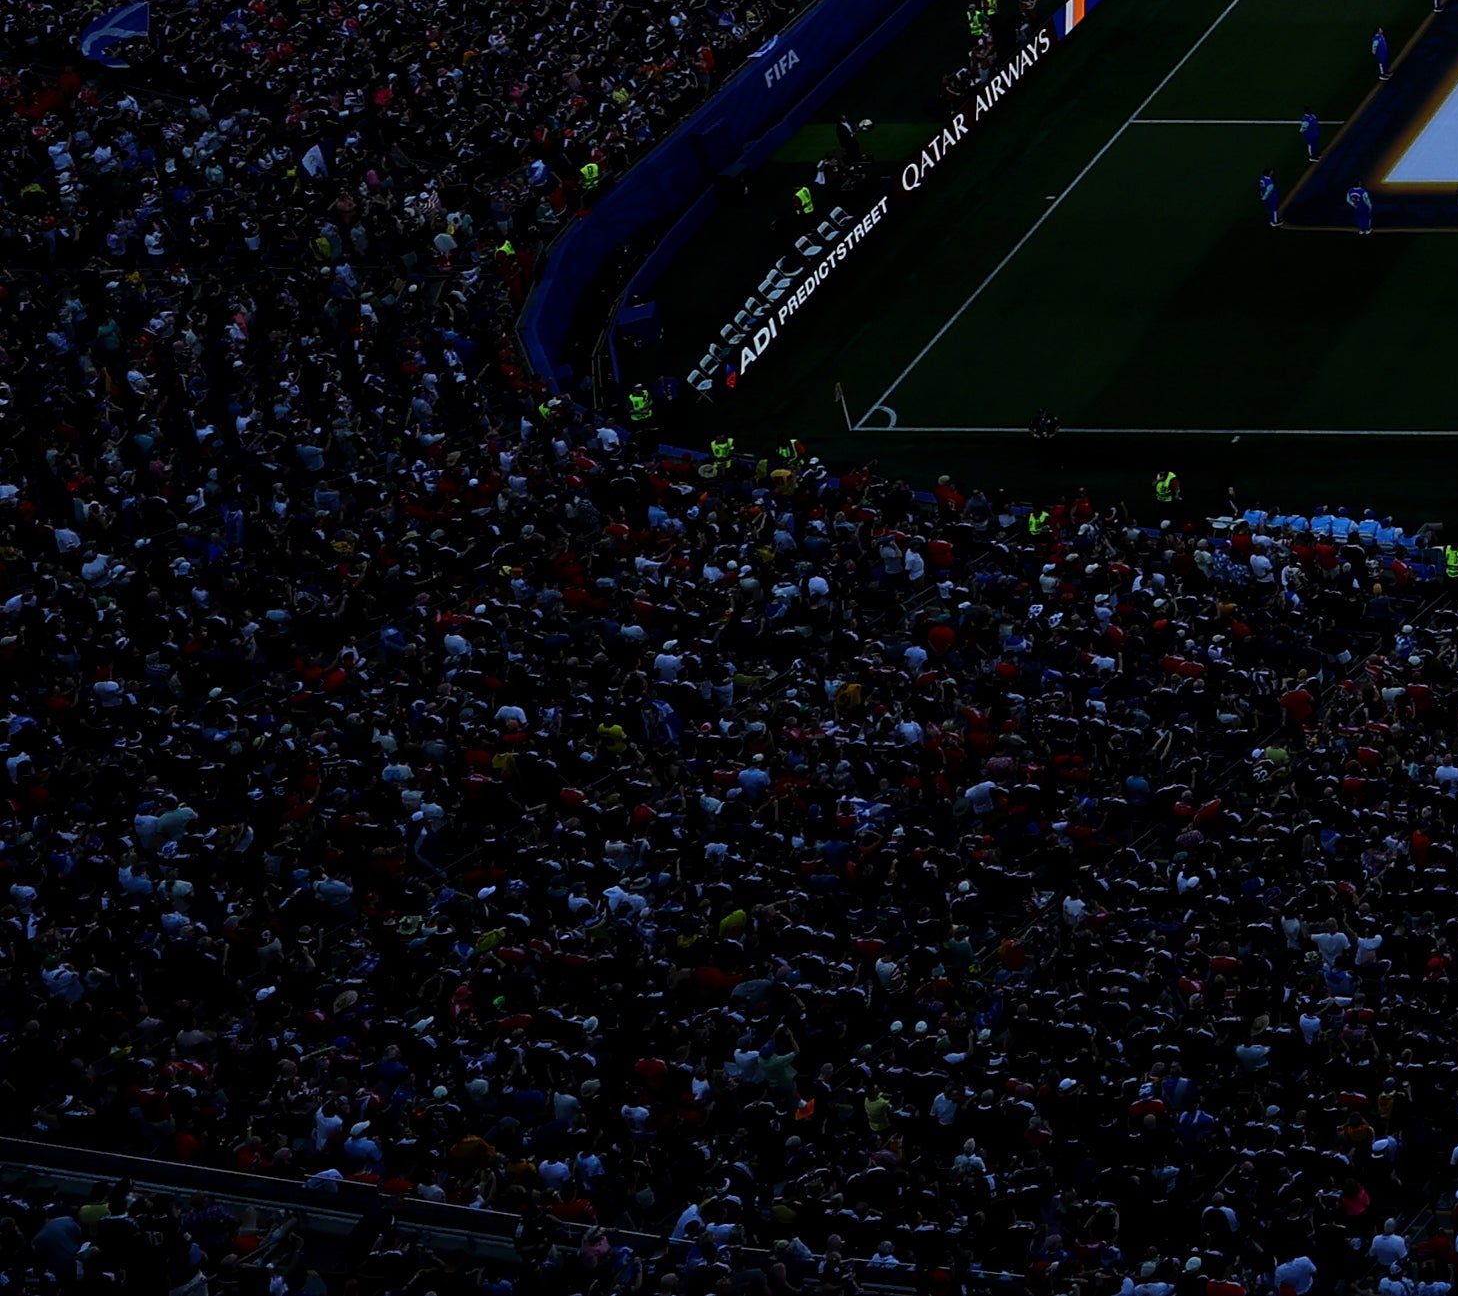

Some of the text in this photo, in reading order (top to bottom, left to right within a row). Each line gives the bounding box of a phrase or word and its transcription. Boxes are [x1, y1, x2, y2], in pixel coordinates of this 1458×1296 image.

[764, 49, 800, 89] FIFA
[974, 28, 1051, 114] AIRWAYS
[901, 113, 968, 192] QATAR
[779, 196, 890, 326] PREDICTSTREET
[738, 317, 779, 375] ADI
